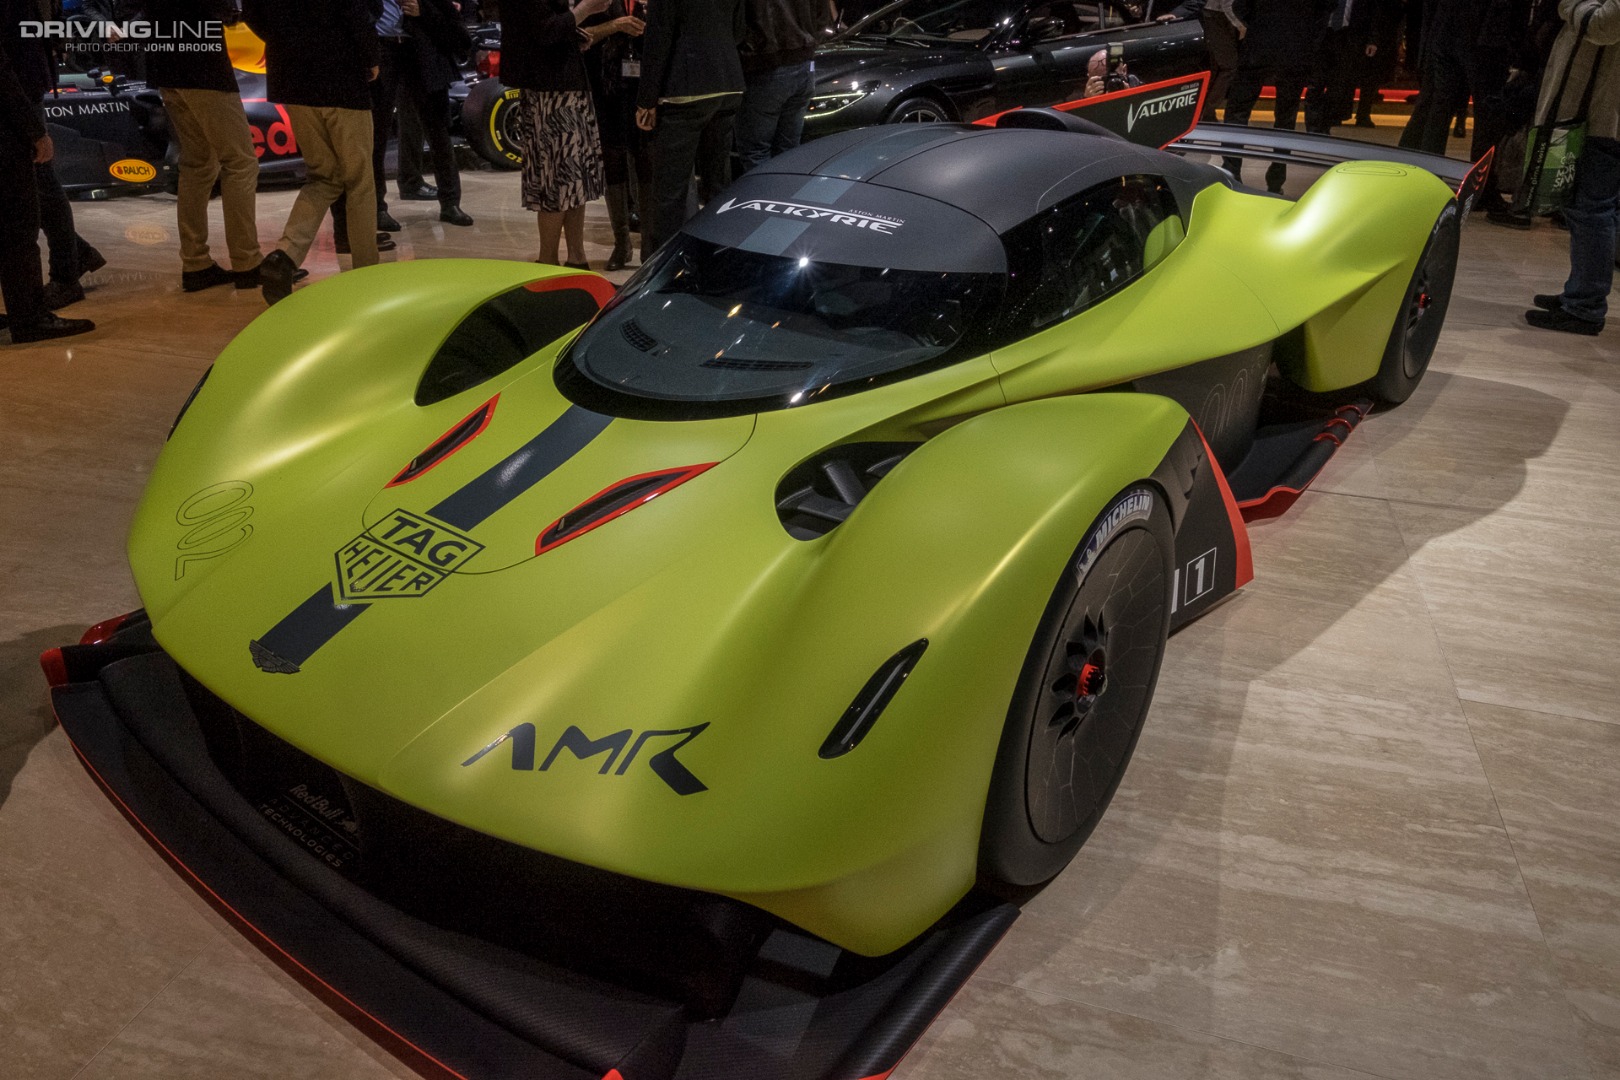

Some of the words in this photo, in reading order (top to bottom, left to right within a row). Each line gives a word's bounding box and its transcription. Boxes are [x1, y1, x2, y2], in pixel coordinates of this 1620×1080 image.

[44, 105, 74, 118] TON
[78, 101, 130, 115] MARTIN
[1127, 87, 1199, 133] VALKYRIE
[122, 165, 151, 175] RAUCH
[716, 197, 903, 235] VALKYRIE
[848, 209, 873, 217] ASTON
[875, 214, 906, 224] MARTIN
[381, 515, 467, 567] TAG
[1095, 494, 1150, 549] MICHELIN
[343, 540, 436, 593] HEUER
[460, 721, 711, 796] AMR
[257, 802, 345, 868] TECHNOLOGIES
